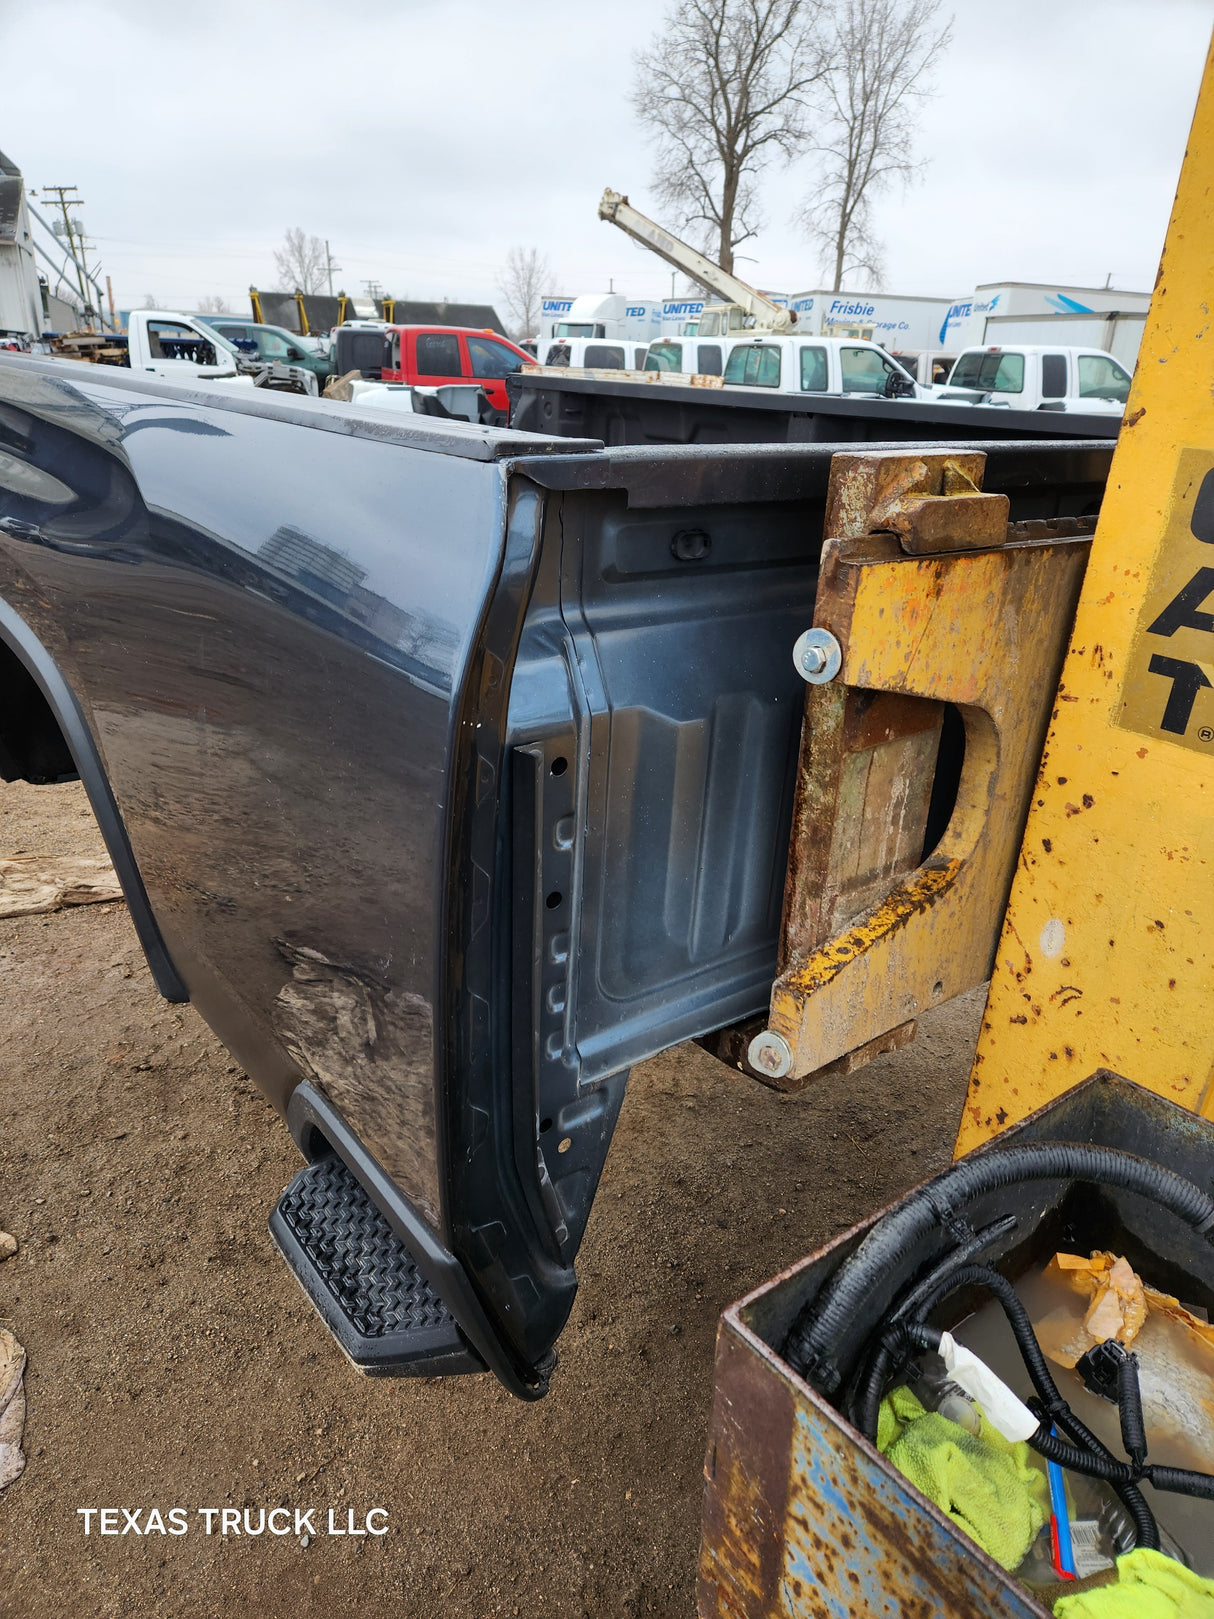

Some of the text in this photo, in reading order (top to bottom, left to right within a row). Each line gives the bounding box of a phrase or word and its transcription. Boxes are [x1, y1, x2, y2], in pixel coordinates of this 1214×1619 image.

[542, 300, 574, 312] UNITE
[625, 307, 646, 317] TED
[663, 303, 704, 314] UNITED
[829, 300, 875, 316] Frisbie
[943, 303, 973, 318] UNITE
